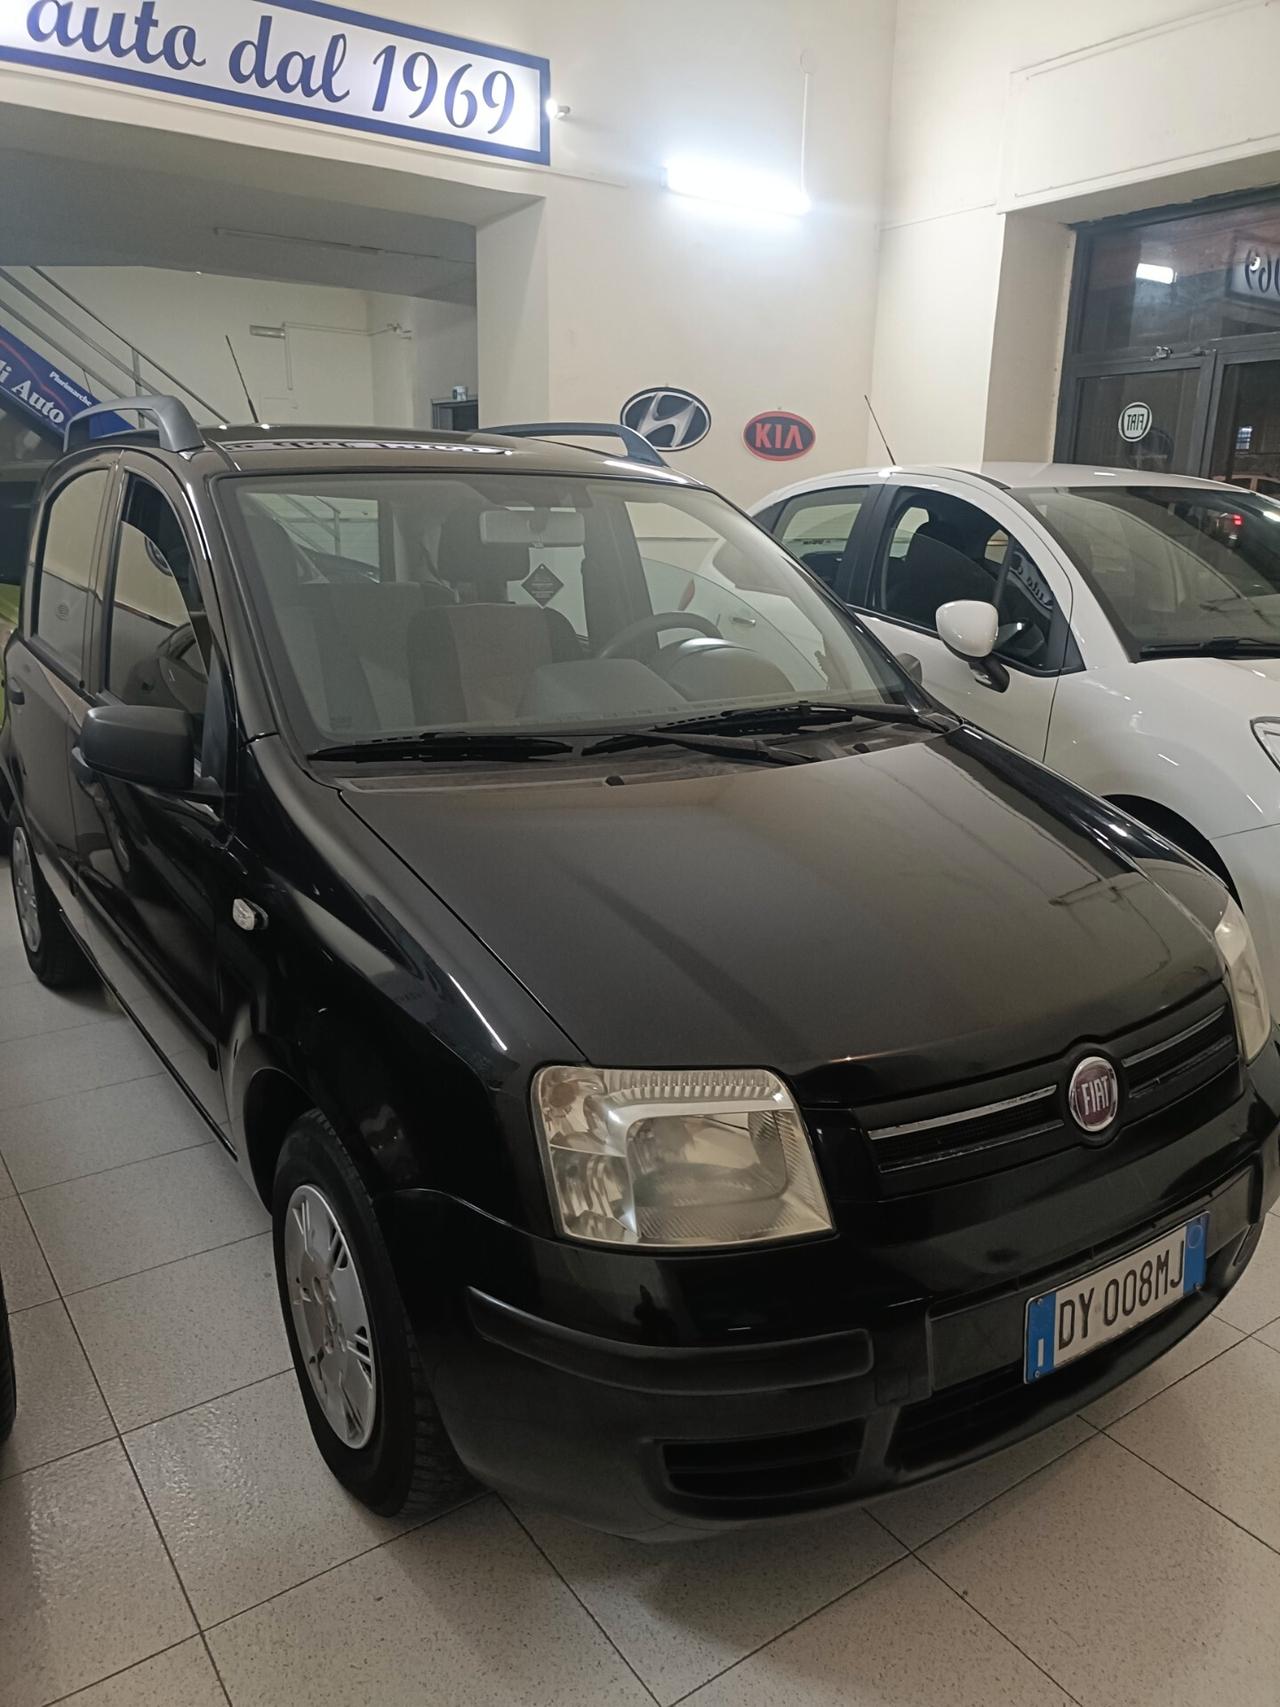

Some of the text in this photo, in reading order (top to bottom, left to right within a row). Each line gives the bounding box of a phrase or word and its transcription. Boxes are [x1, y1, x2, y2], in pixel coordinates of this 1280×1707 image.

[26, 0, 516, 135] auto dal 1969
[11, 380, 65, 424] Auto
[755, 423, 804, 450] KIA
[1080, 1075, 1109, 1116] FIAT
